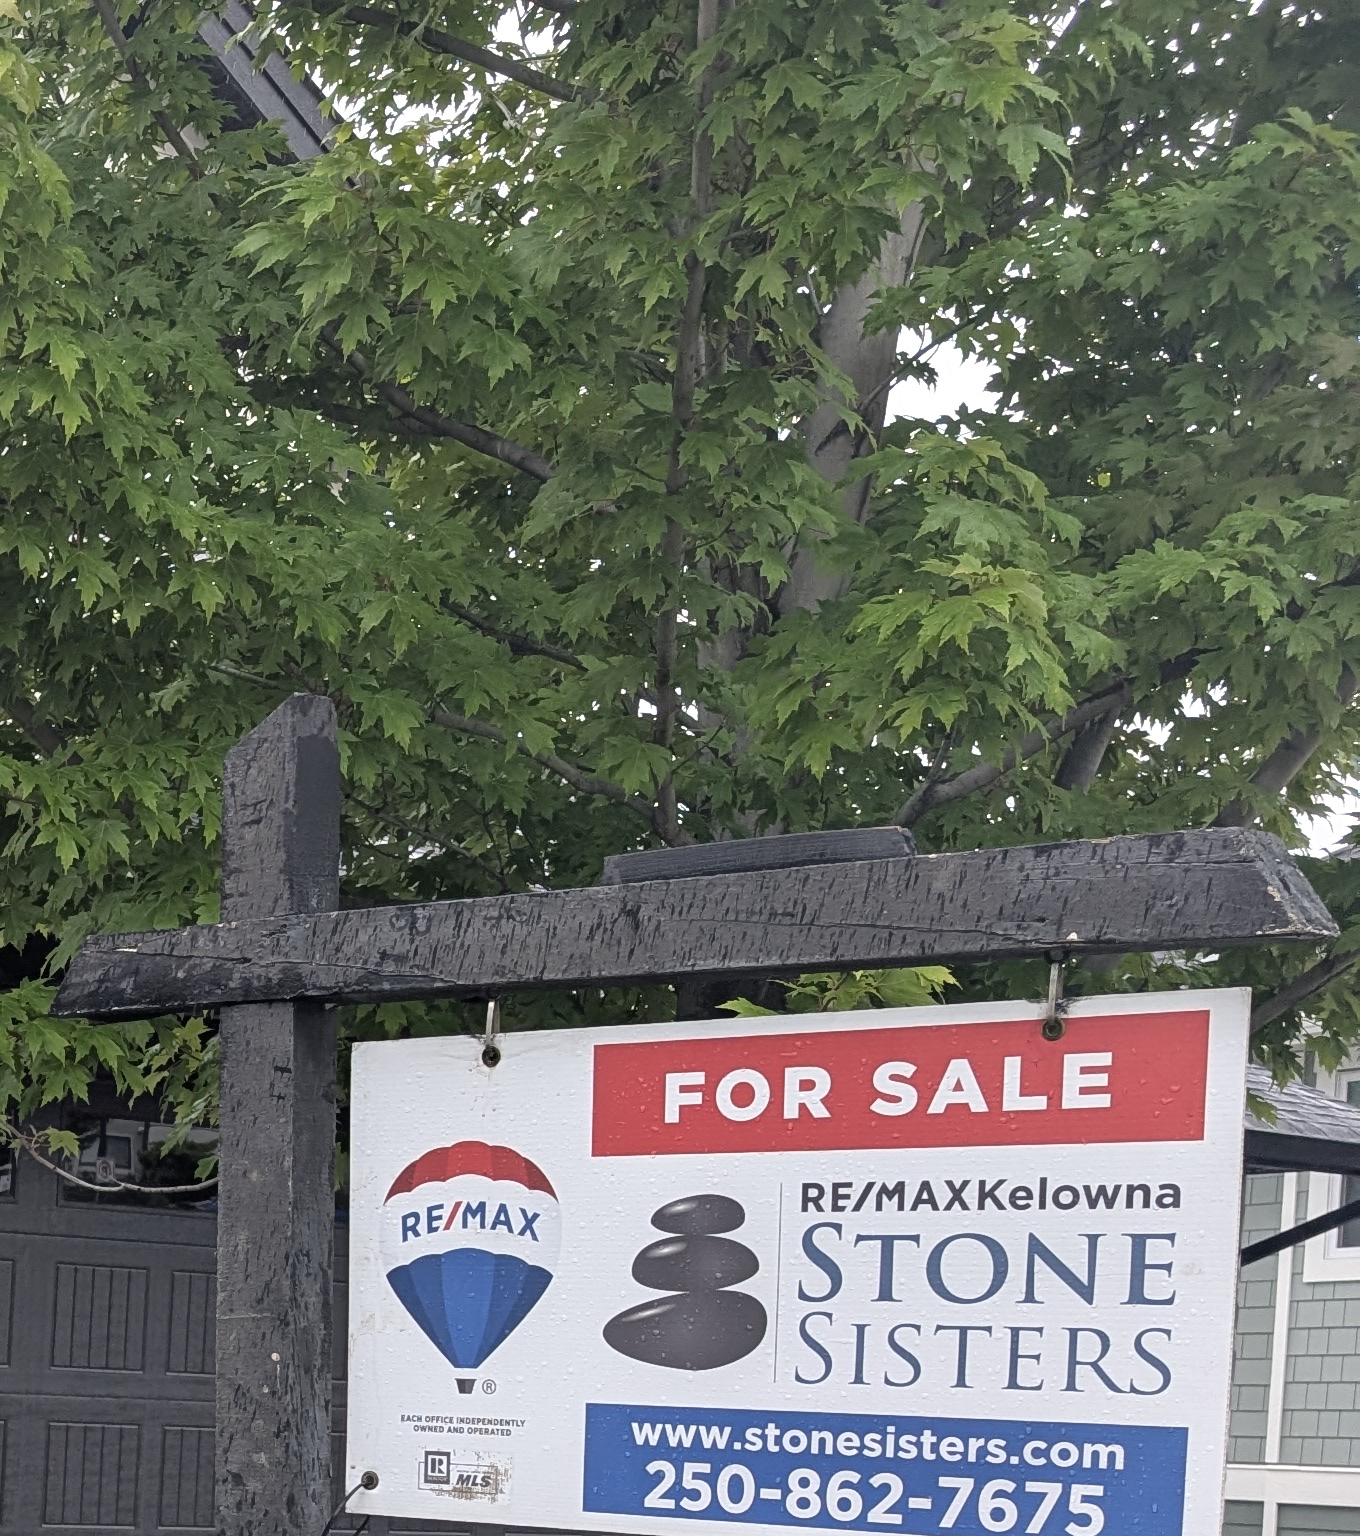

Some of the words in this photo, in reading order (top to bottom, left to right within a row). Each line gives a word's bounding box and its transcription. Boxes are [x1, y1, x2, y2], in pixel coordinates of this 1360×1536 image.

[664, 1066, 833, 1124] FOR
[869, 1051, 1113, 1116] SALE
[400, 1200, 542, 1243] RE/MAX
[400, 1414, 423, 1423] EACH
[424, 1415, 454, 1425] OFFICE
[456, 1416, 526, 1428] INDEPENDENTLY
[413, 1424, 445, 1434] OWNED
[446, 1425, 465, 1434] AND
[466, 1427, 512, 1437] OPERATED
[630, 1422, 1125, 1471] www.stonesisters.com
[455, 1473, 492, 1488] MLS
